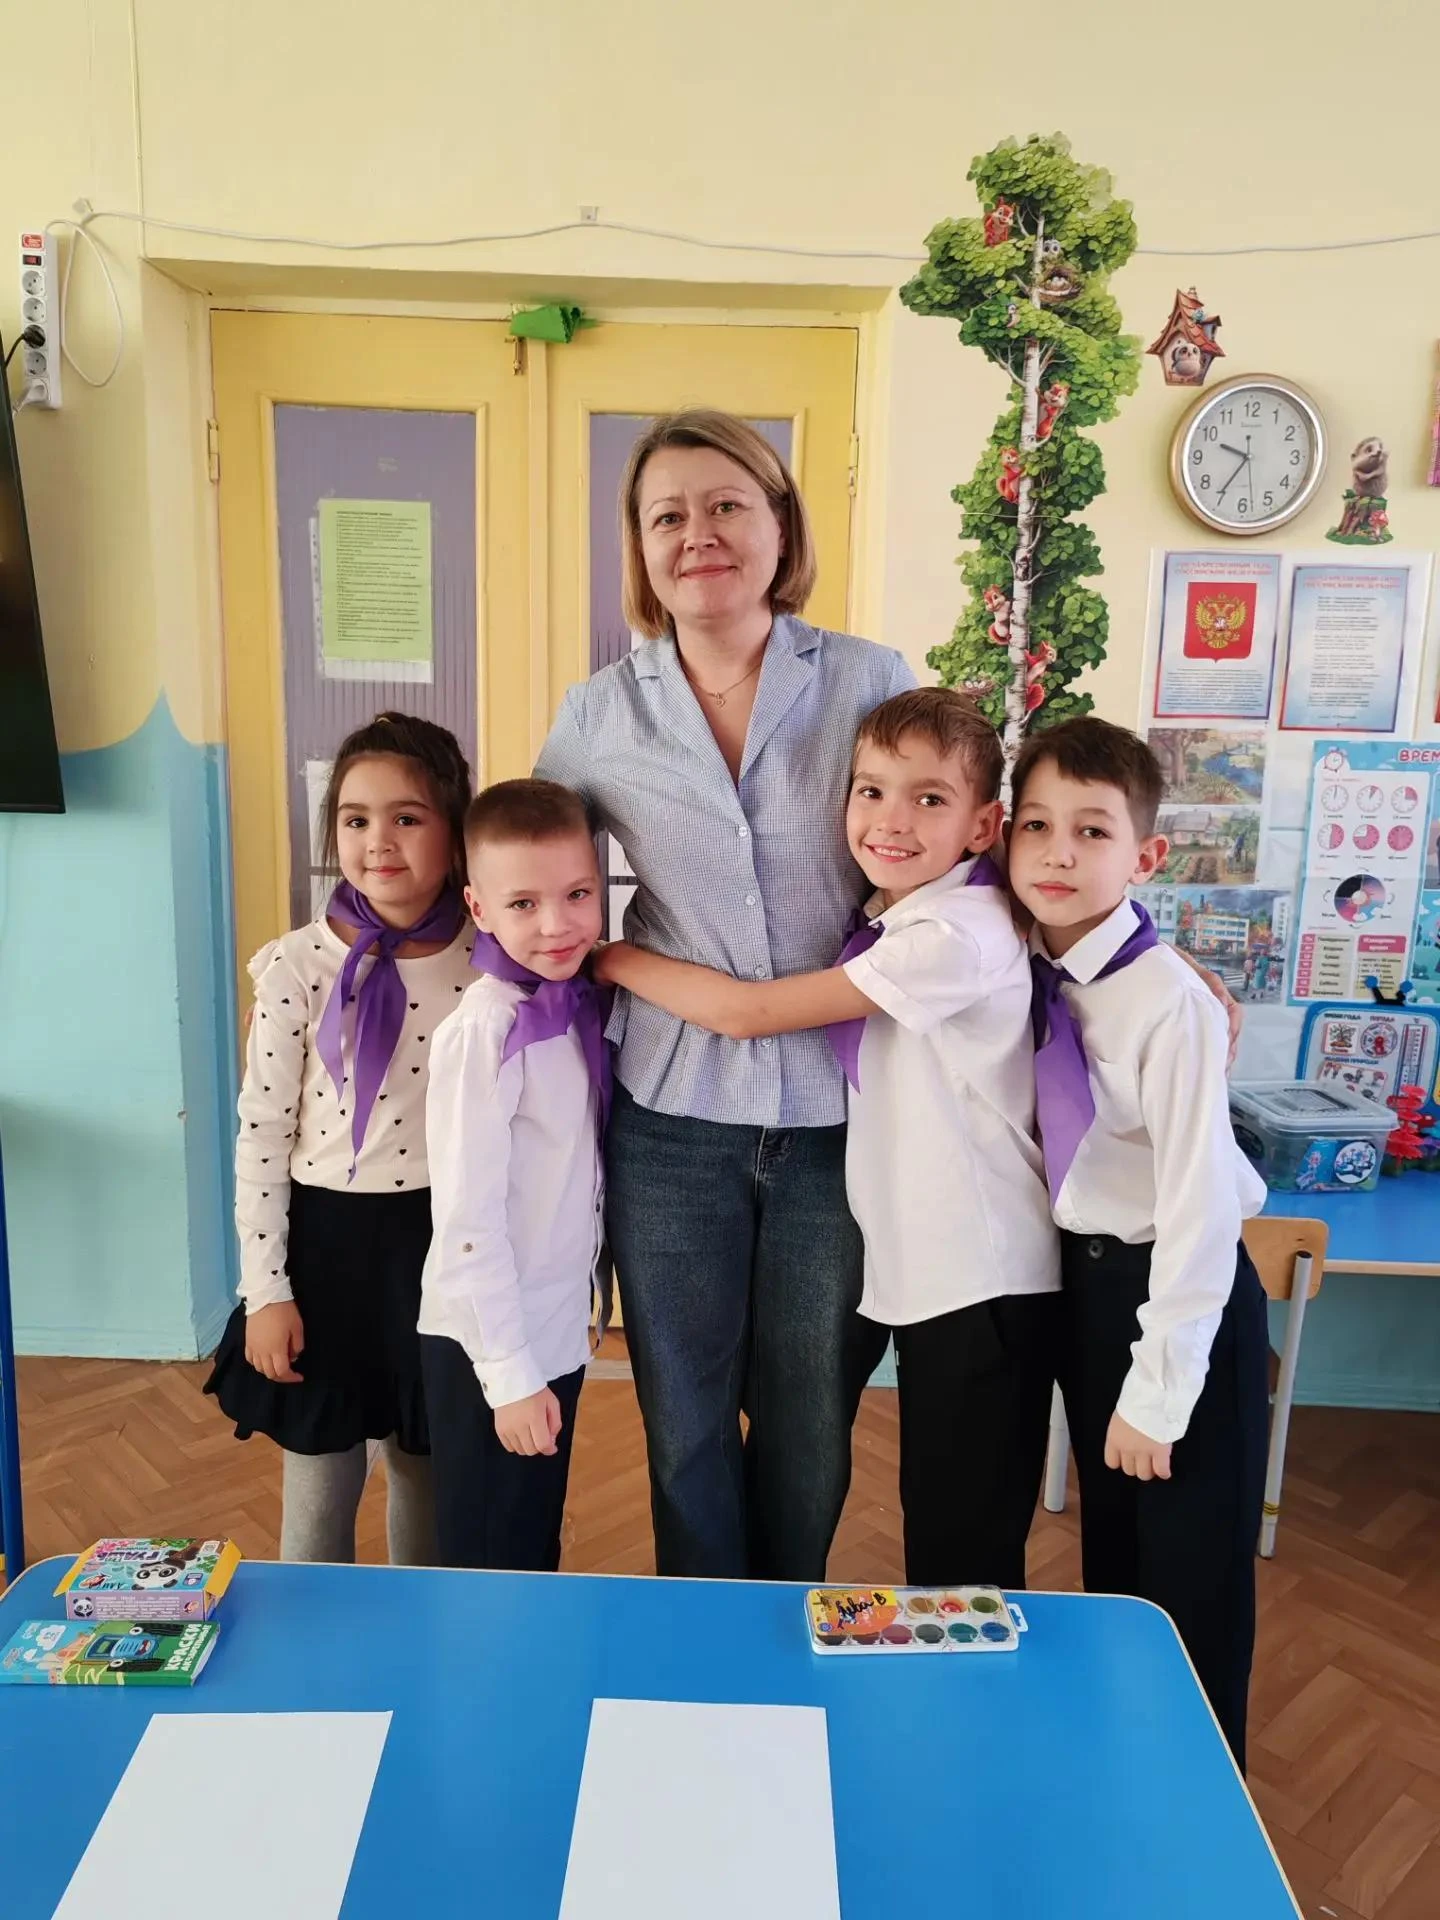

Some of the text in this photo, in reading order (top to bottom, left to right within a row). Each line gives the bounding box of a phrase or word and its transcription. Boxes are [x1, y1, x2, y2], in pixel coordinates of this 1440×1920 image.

[1220, 408, 1233, 425] 11
[1244, 401, 1261, 418] 12
[1273, 408, 1279, 425] 1
[1202, 425, 1218, 442] 10
[1284, 425, 1296, 442] 2
[1192, 450, 1203, 466] 9
[1289, 450, 1300, 466] 3
[1200, 474, 1211, 490] 8
[1279, 474, 1290, 490] 4
[1216, 491, 1226, 506] 7
[1237, 498, 1248, 514] 6
[1263, 491, 1273, 507] 5
[163, 1624, 202, 1672] КРАСКИ
